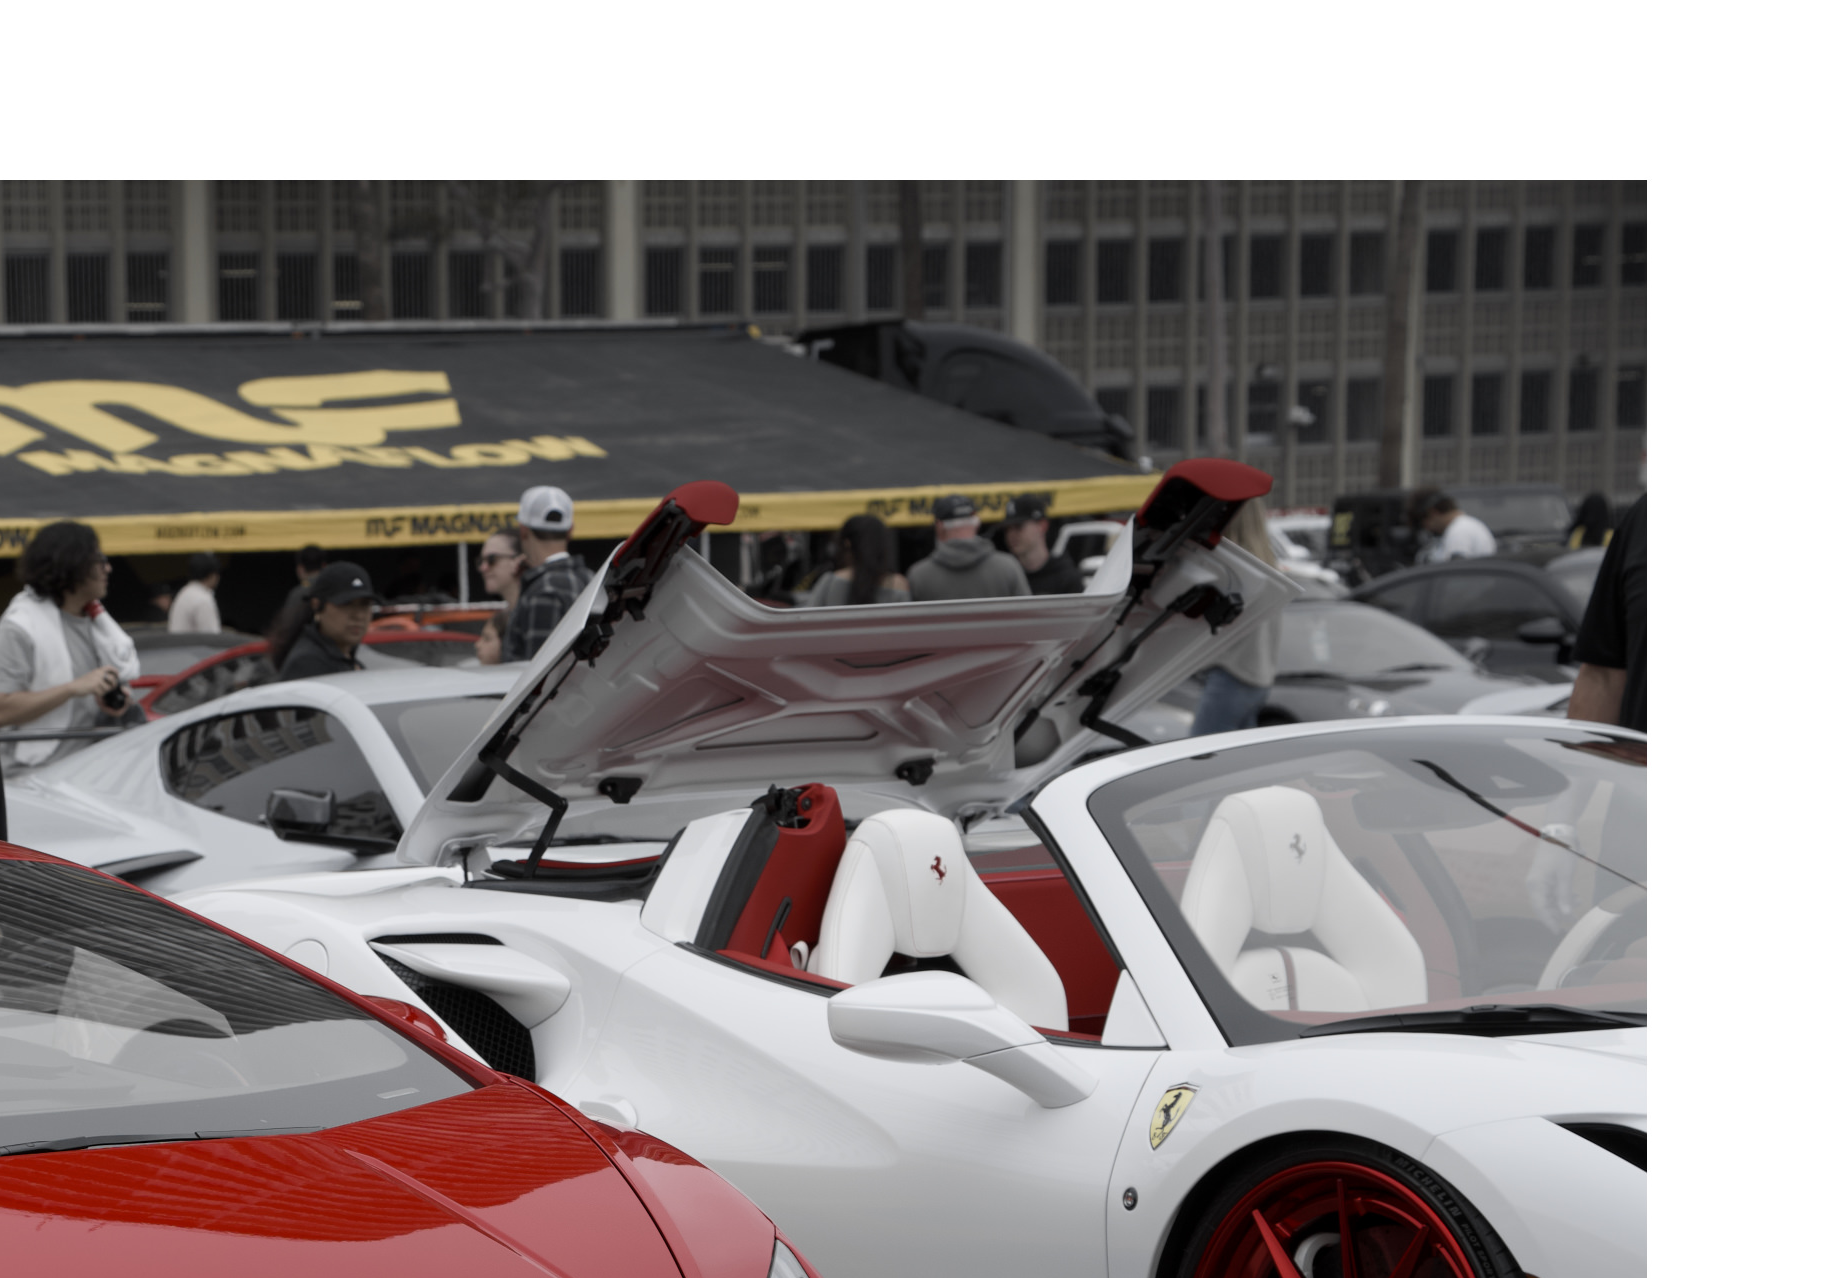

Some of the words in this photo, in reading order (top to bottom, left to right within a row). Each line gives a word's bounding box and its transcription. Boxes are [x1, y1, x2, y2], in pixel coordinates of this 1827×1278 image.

[16, 433, 609, 478] MAGNAFLOW
[411, 513, 518, 536] MAGNAF
[1394, 1156, 1462, 1217] MICHELIN
[1460, 1223, 1481, 1248] PILOT
